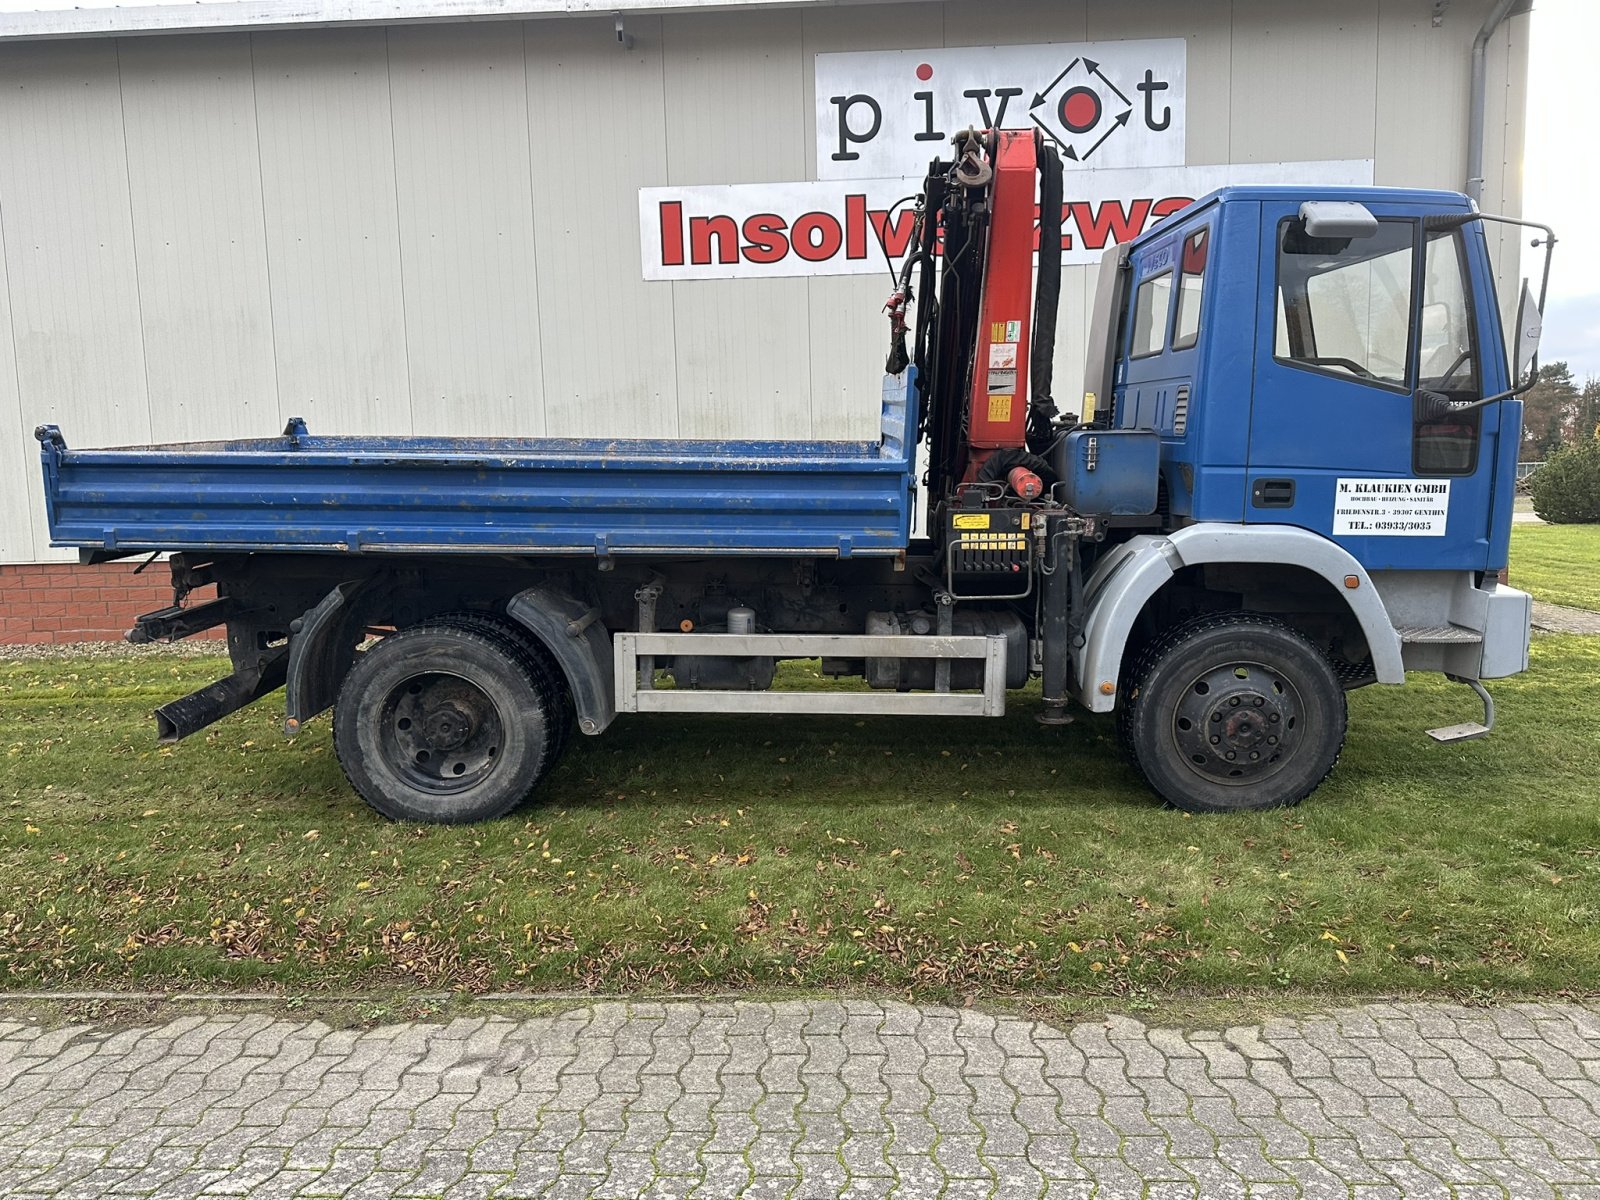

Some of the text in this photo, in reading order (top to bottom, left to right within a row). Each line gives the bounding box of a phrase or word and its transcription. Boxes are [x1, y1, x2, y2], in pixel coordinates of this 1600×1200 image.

[830, 62, 1171, 161] pivot
[1339, 483, 1447, 494] M. KLAUKIEN GMBH
[1348, 521, 1432, 531] TEL.: 03933/3035
